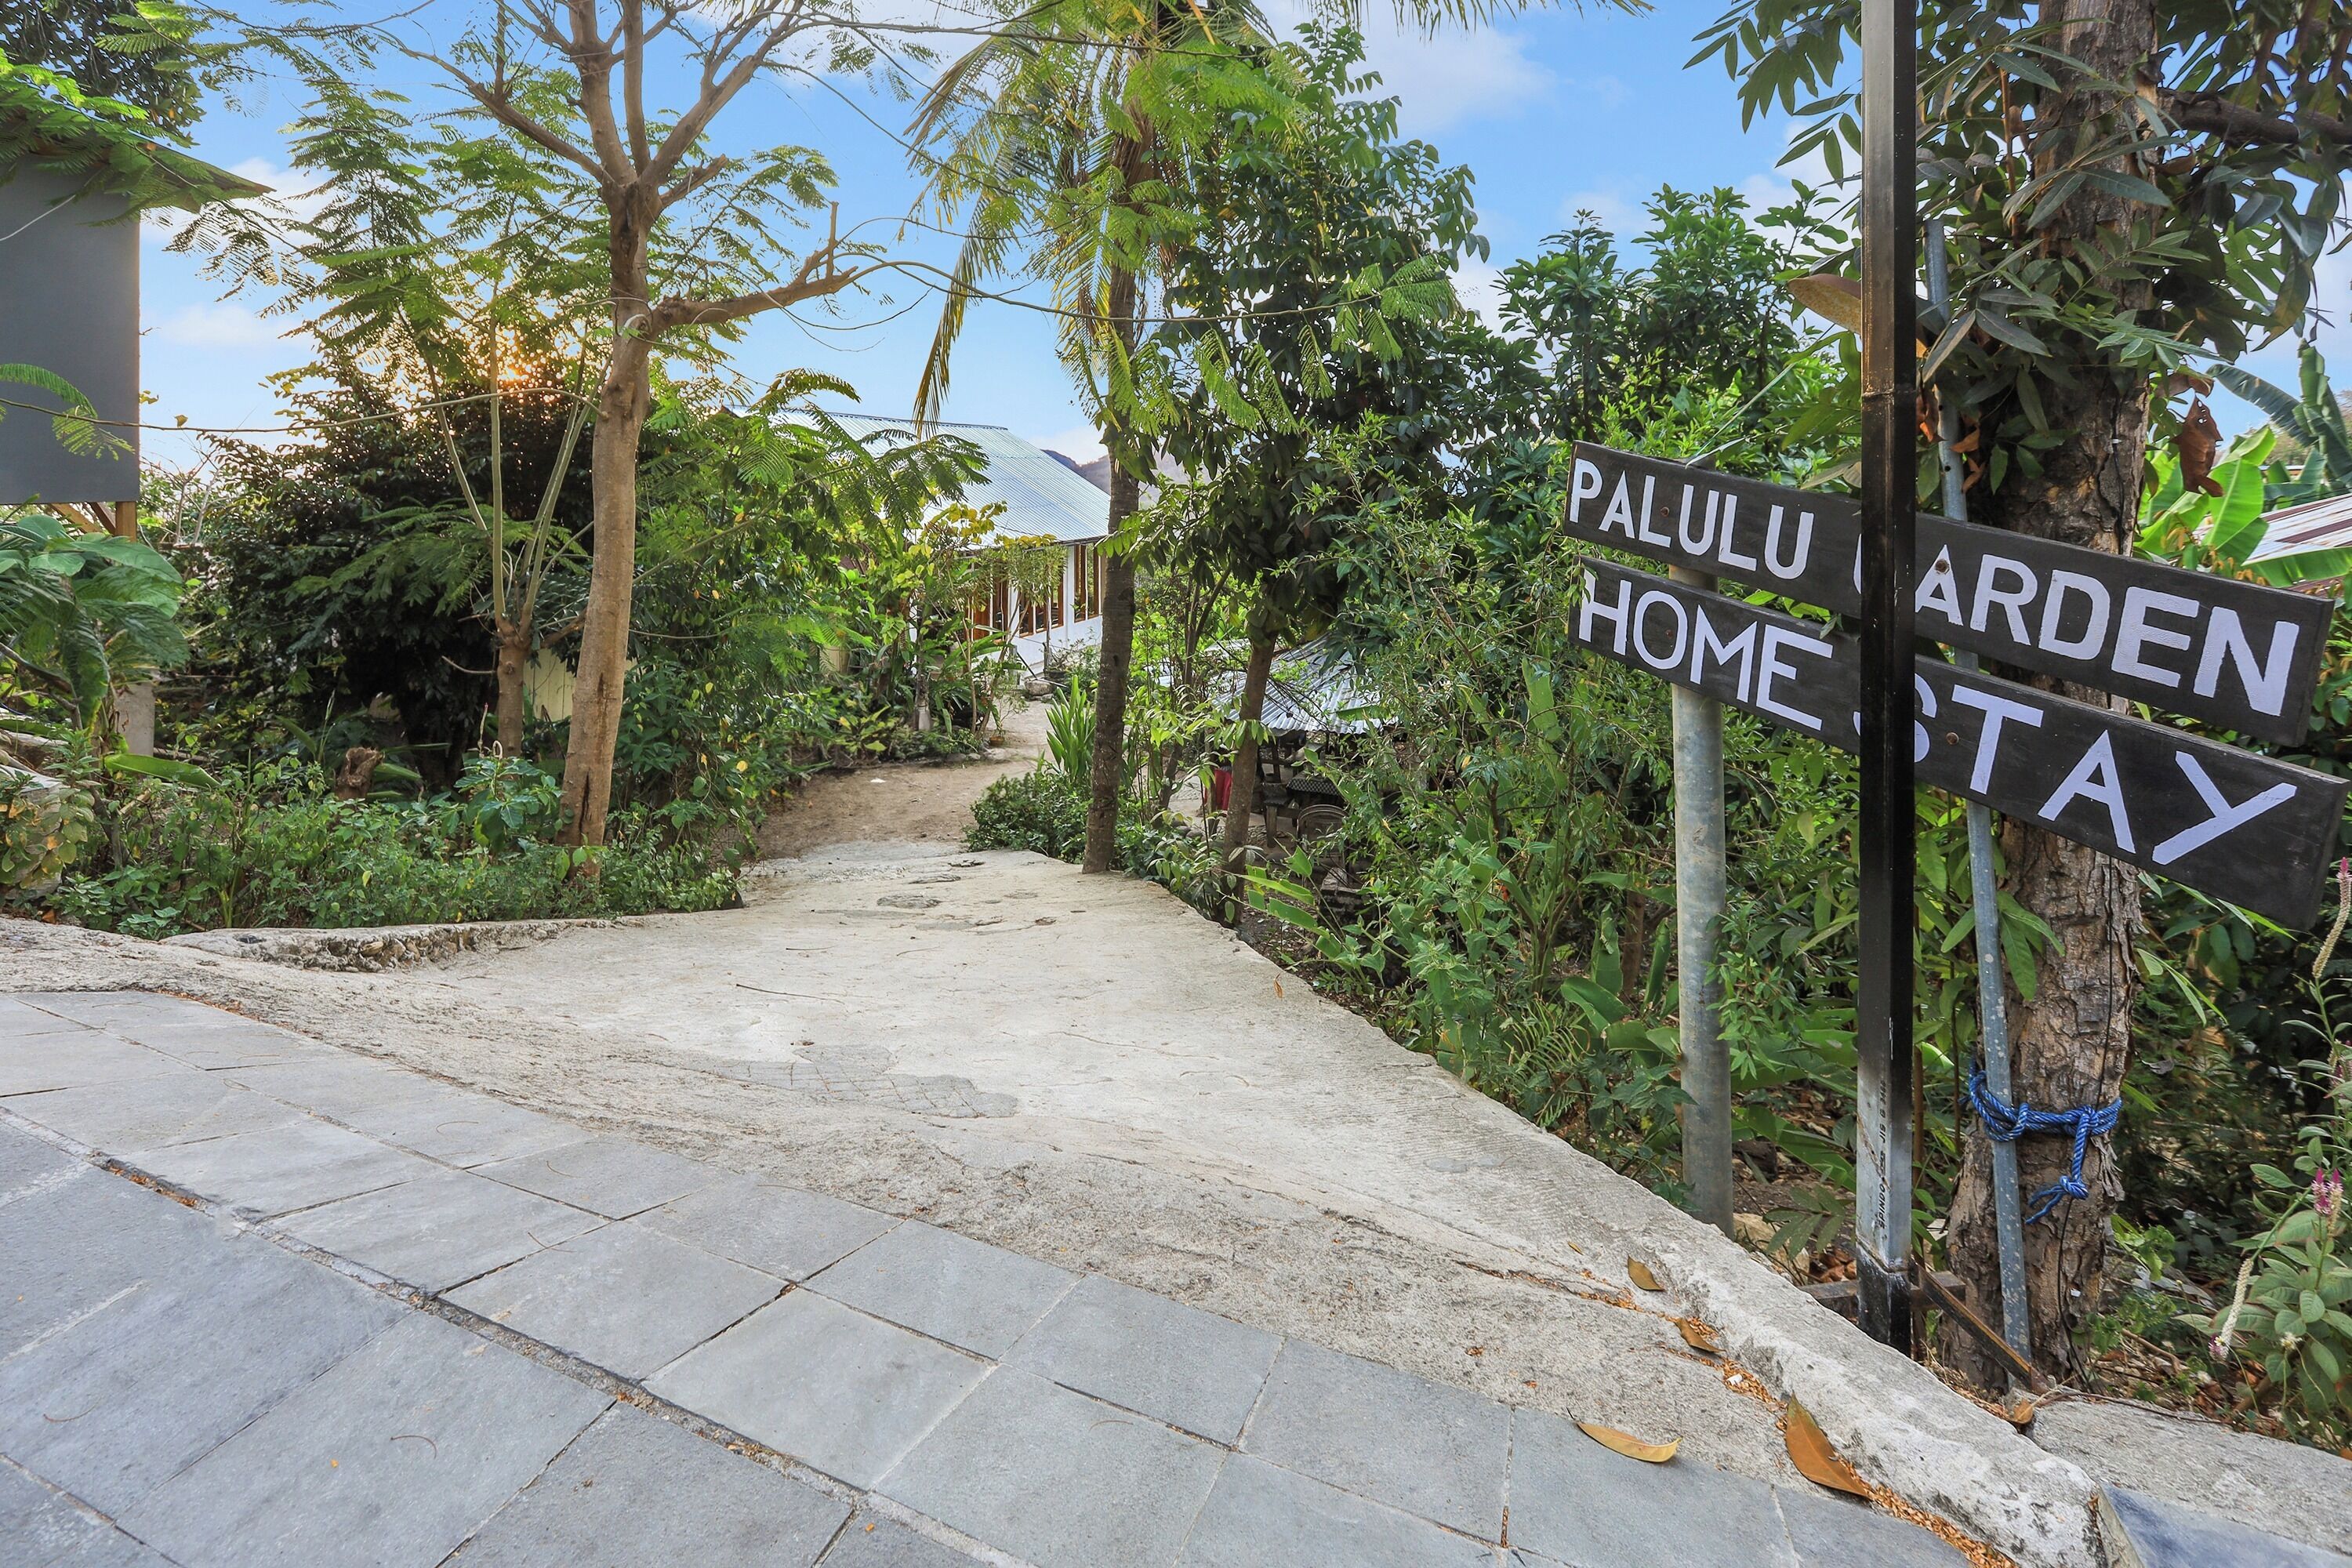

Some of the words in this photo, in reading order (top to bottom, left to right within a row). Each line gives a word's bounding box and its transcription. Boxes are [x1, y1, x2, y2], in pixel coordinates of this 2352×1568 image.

[1570, 457, 1814, 579] PALULU
[1853, 532, 2299, 717] ARDEN
[1578, 567, 1835, 731] HOME
